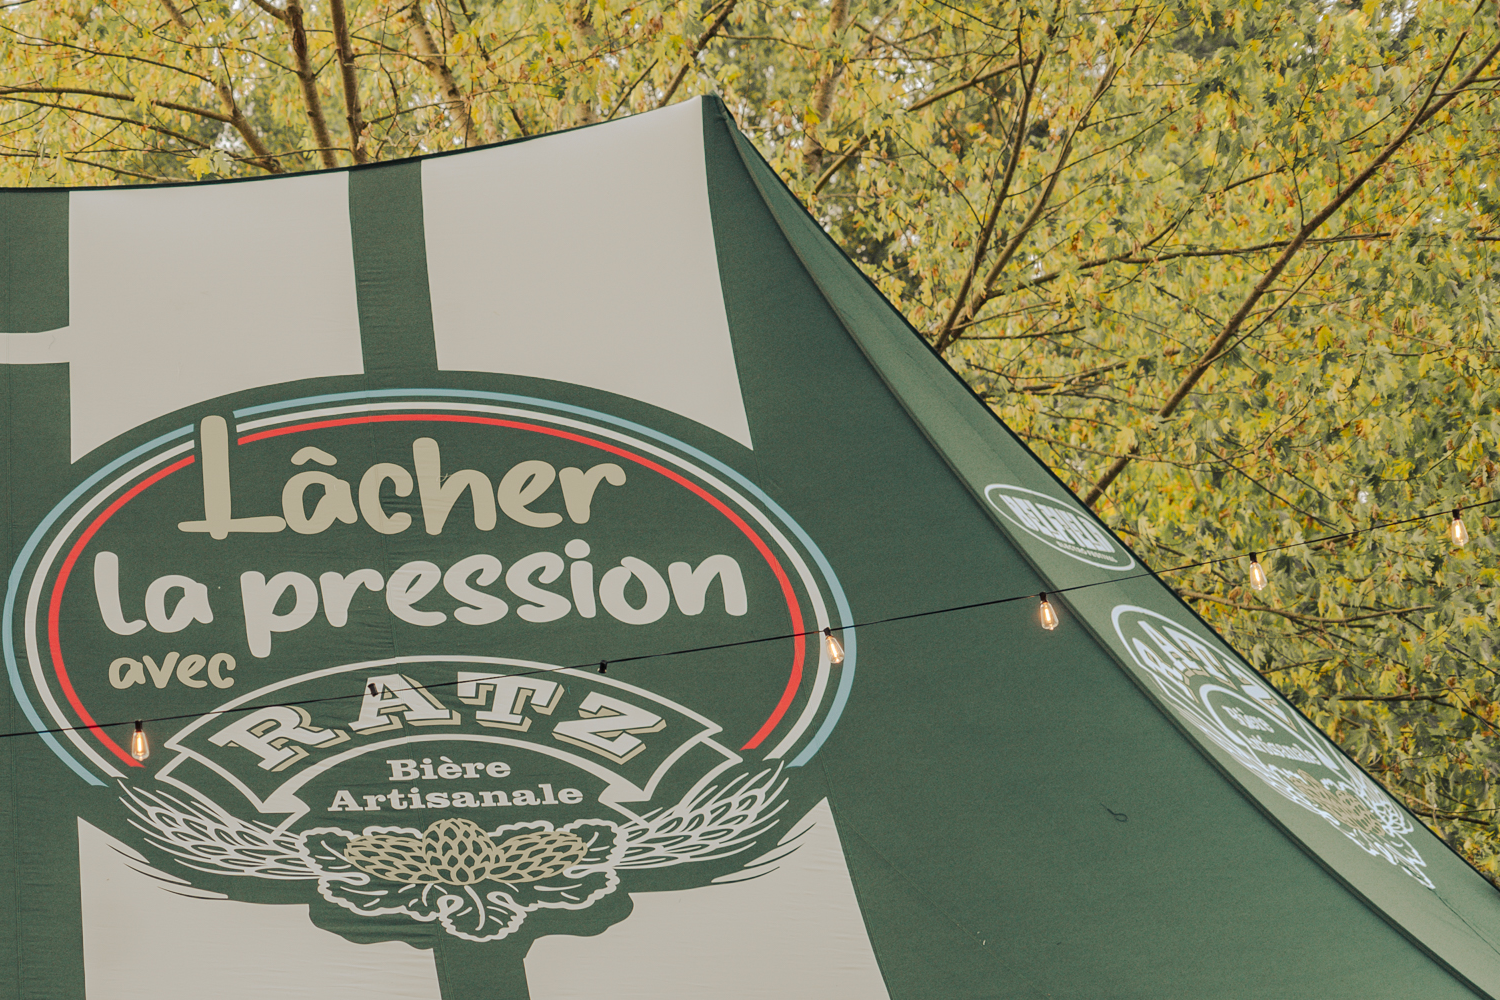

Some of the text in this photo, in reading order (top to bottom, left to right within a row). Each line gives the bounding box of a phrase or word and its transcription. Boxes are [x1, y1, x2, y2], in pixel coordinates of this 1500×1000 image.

[177, 415, 627, 540] Lâcher
[93, 538, 749, 659] la pression
[108, 651, 235, 691] avec
[208, 672, 666, 774] RATZ
[328, 782, 584, 813] Artisanale
[386, 756, 512, 783] Bière
